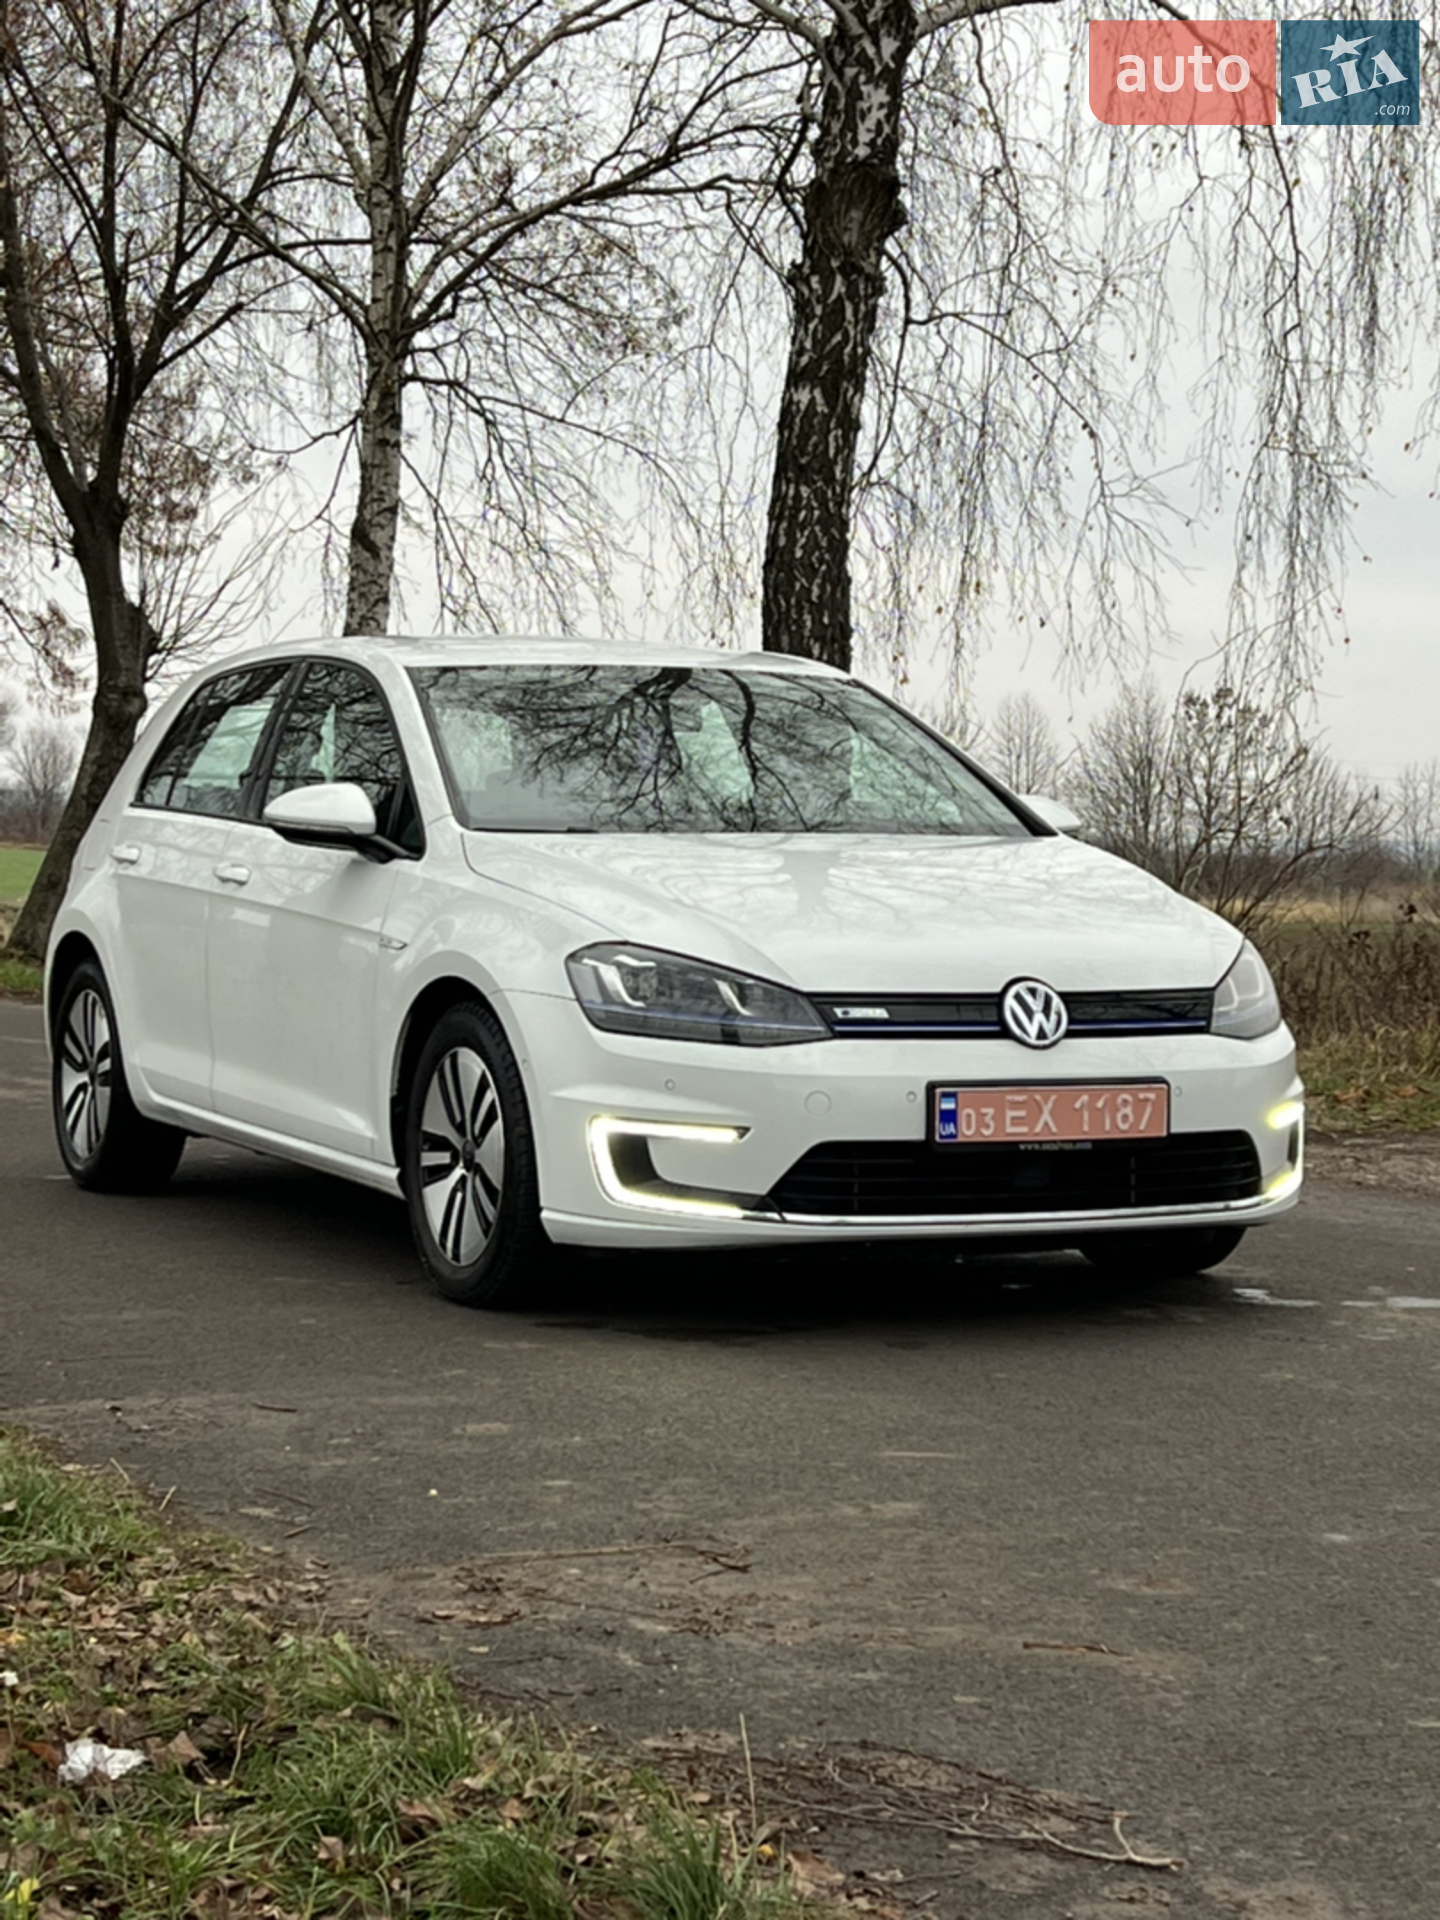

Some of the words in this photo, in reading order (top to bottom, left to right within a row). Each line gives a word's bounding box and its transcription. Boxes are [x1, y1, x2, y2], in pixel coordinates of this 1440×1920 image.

[961, 1108, 995, 1136] 03
[1005, 1095, 1058, 1134] EX
[1074, 1093, 1156, 1132] 1187
[939, 1122, 956, 1136] UA
